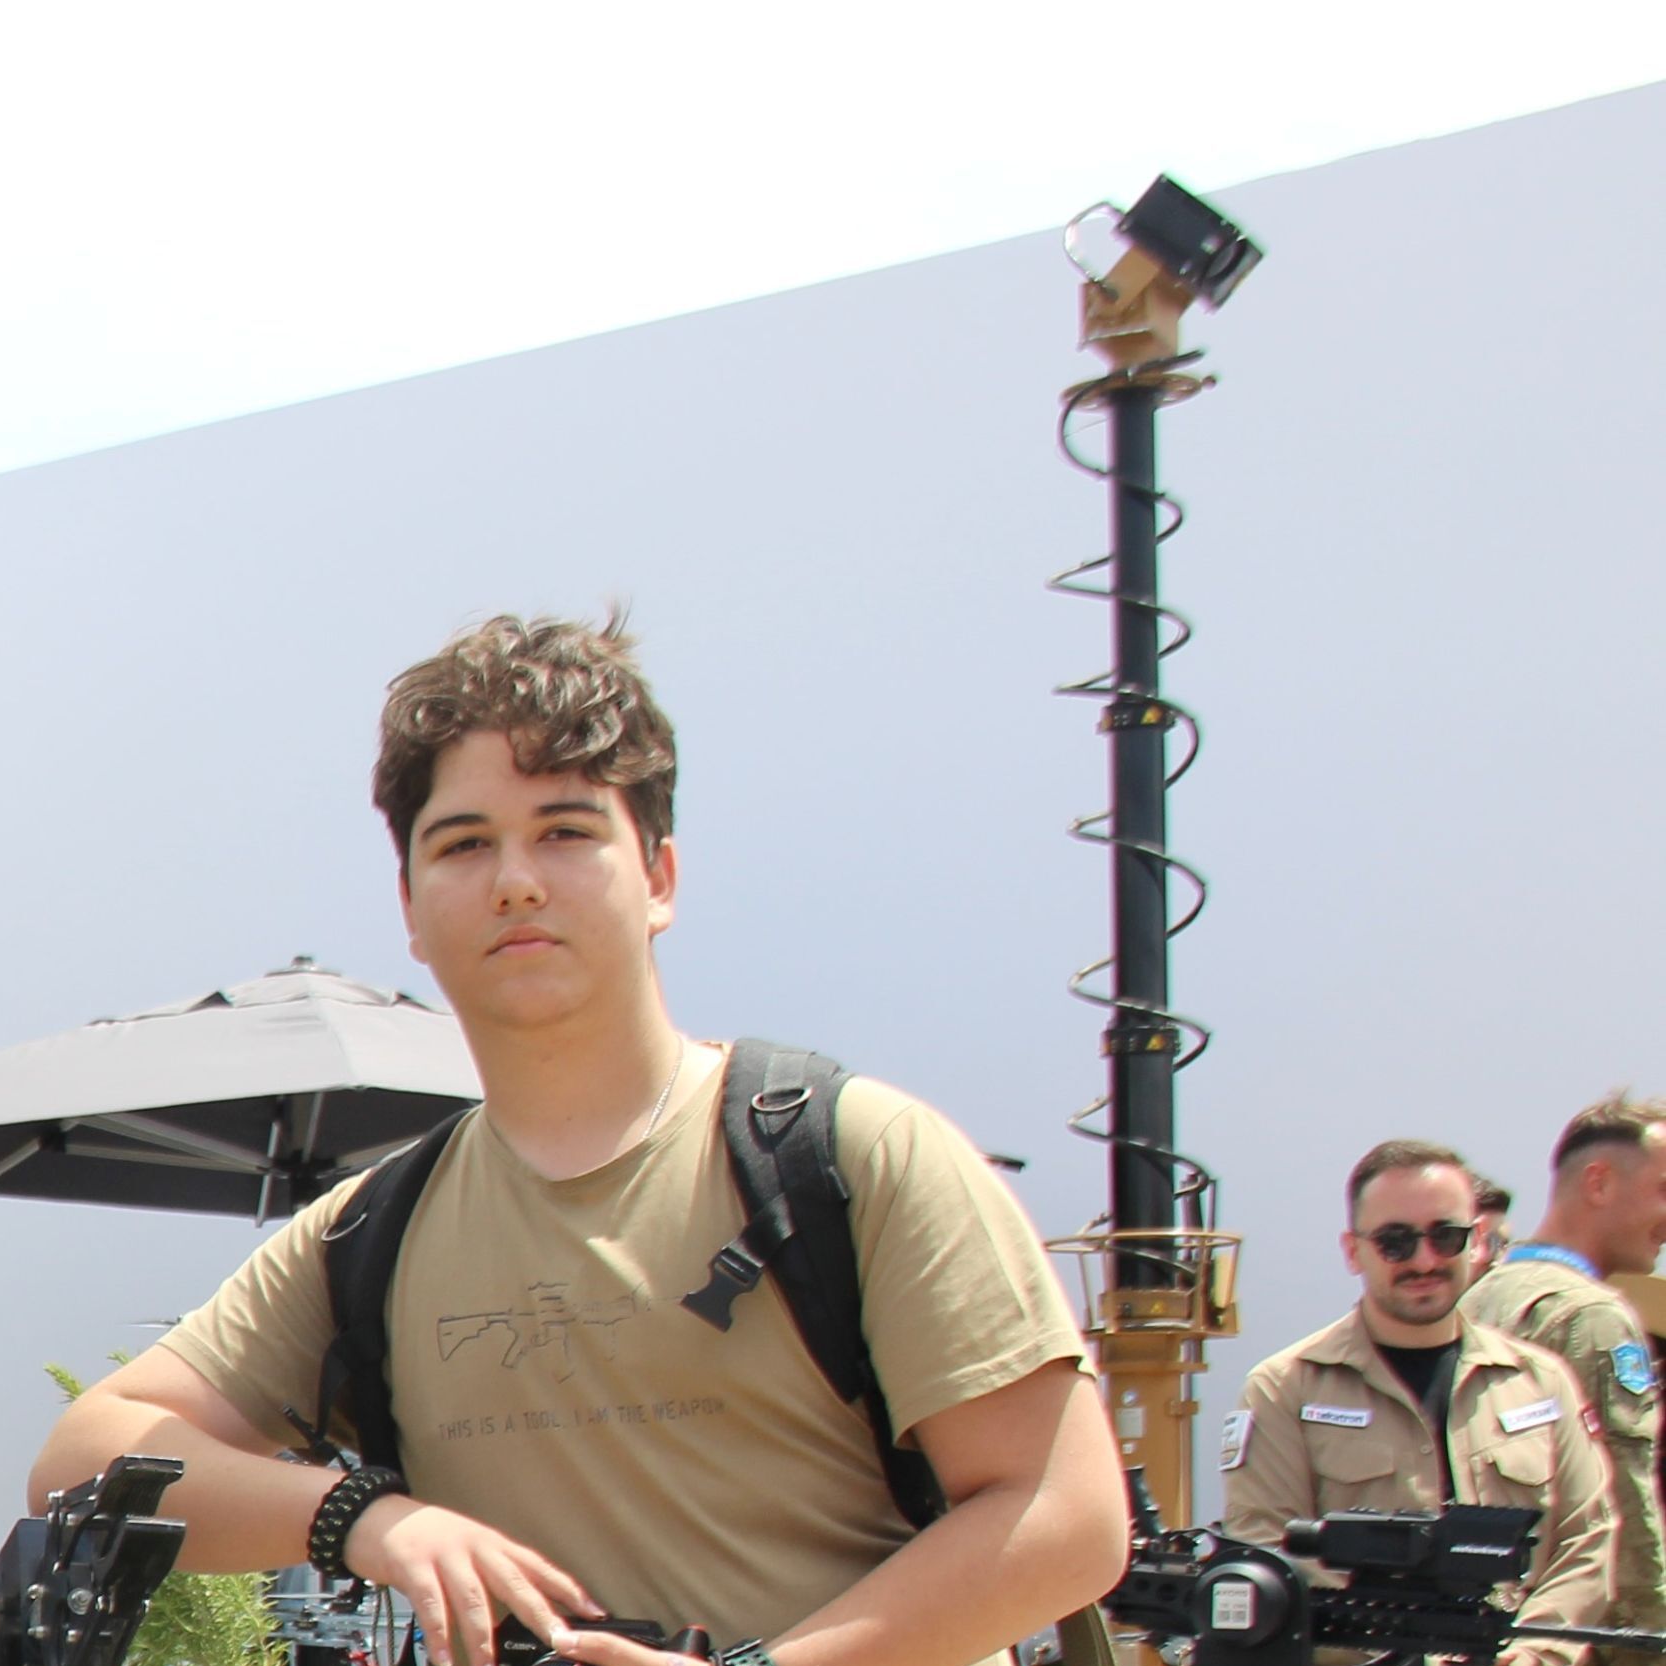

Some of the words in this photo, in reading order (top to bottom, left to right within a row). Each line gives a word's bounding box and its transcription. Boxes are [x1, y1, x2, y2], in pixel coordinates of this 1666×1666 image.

[439, 1419, 472, 1441] THIS
[481, 1417, 495, 1434] IS
[505, 1414, 515, 1432] A
[618, 1405, 647, 1424] THE
